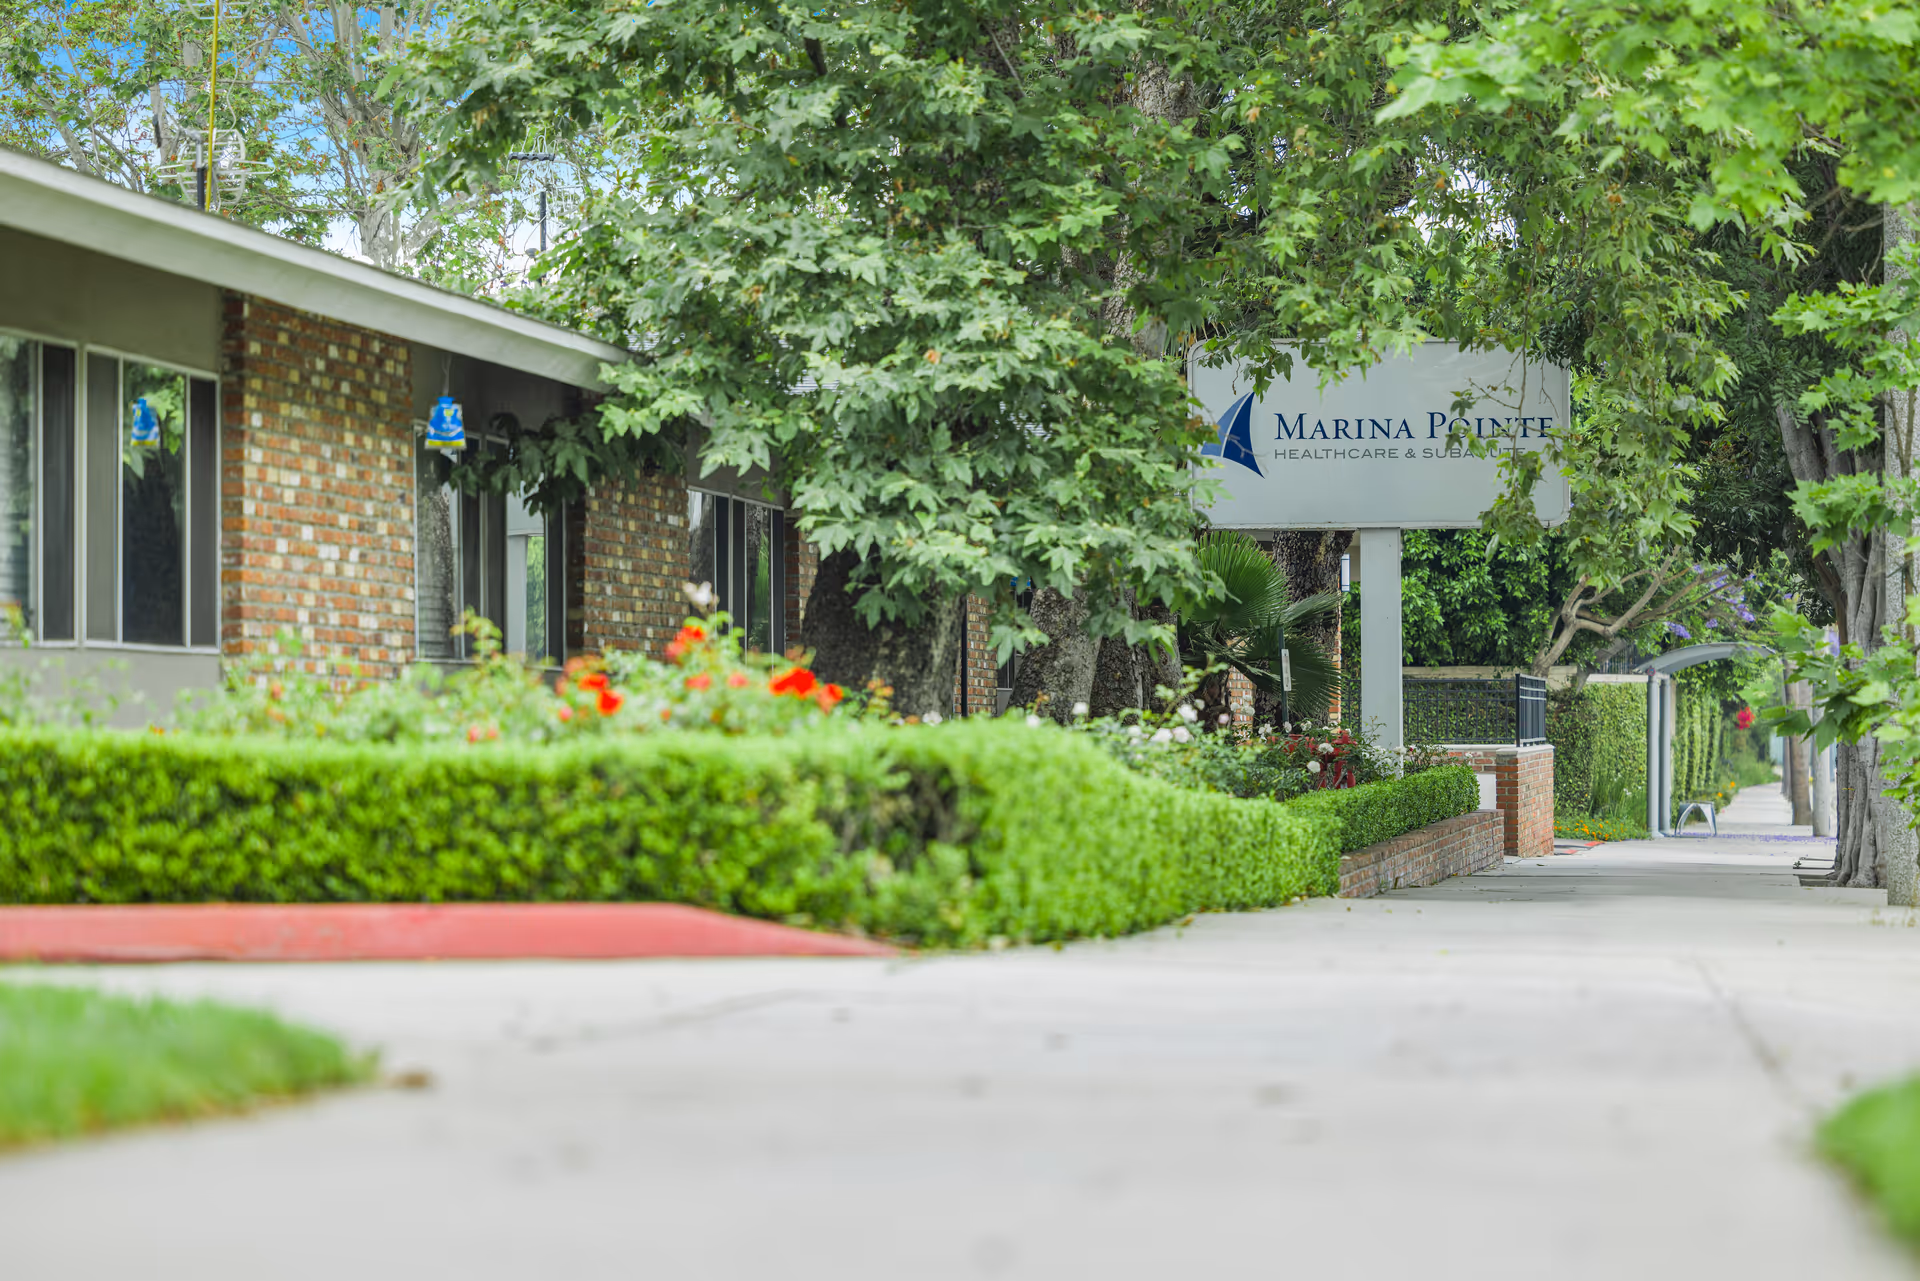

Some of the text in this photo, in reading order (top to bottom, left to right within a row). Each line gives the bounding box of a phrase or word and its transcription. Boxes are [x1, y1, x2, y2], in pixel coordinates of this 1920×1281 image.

[1273, 412, 1416, 440] MARINA
[1274, 447, 1526, 460] HEALTHCARE & SUBAUTE
